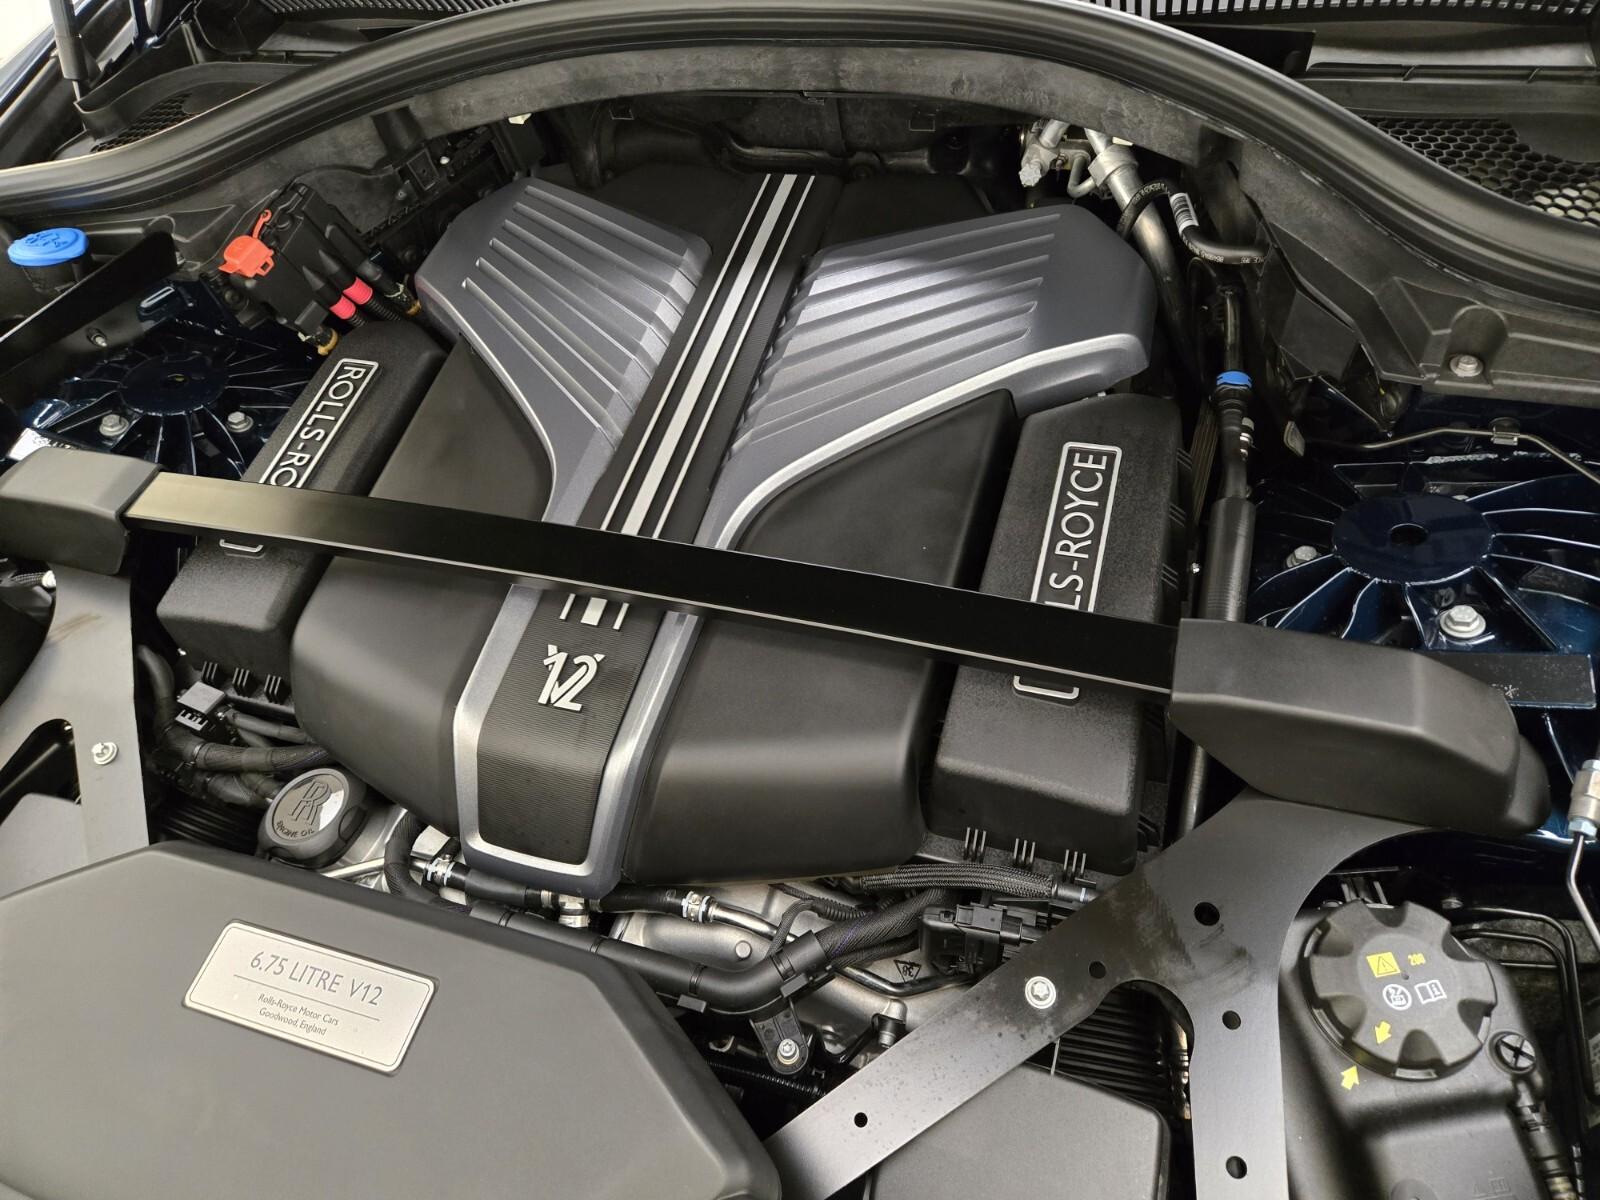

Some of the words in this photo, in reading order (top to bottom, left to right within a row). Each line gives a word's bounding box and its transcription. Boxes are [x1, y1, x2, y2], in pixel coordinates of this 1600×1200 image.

[276, 820, 298, 838] ENGINE
[250, 951, 288, 976] 6.75
[288, 961, 344, 993] LITRE
[350, 978, 383, 1006] V12
[257, 993, 298, 1014] Rolls-Royce
[299, 1006, 321, 1021] Motor
[322, 1013, 339, 1027] Cars
[259, 1007, 299, 1028] Goodwood,
[299, 1021, 327, 1036] England
